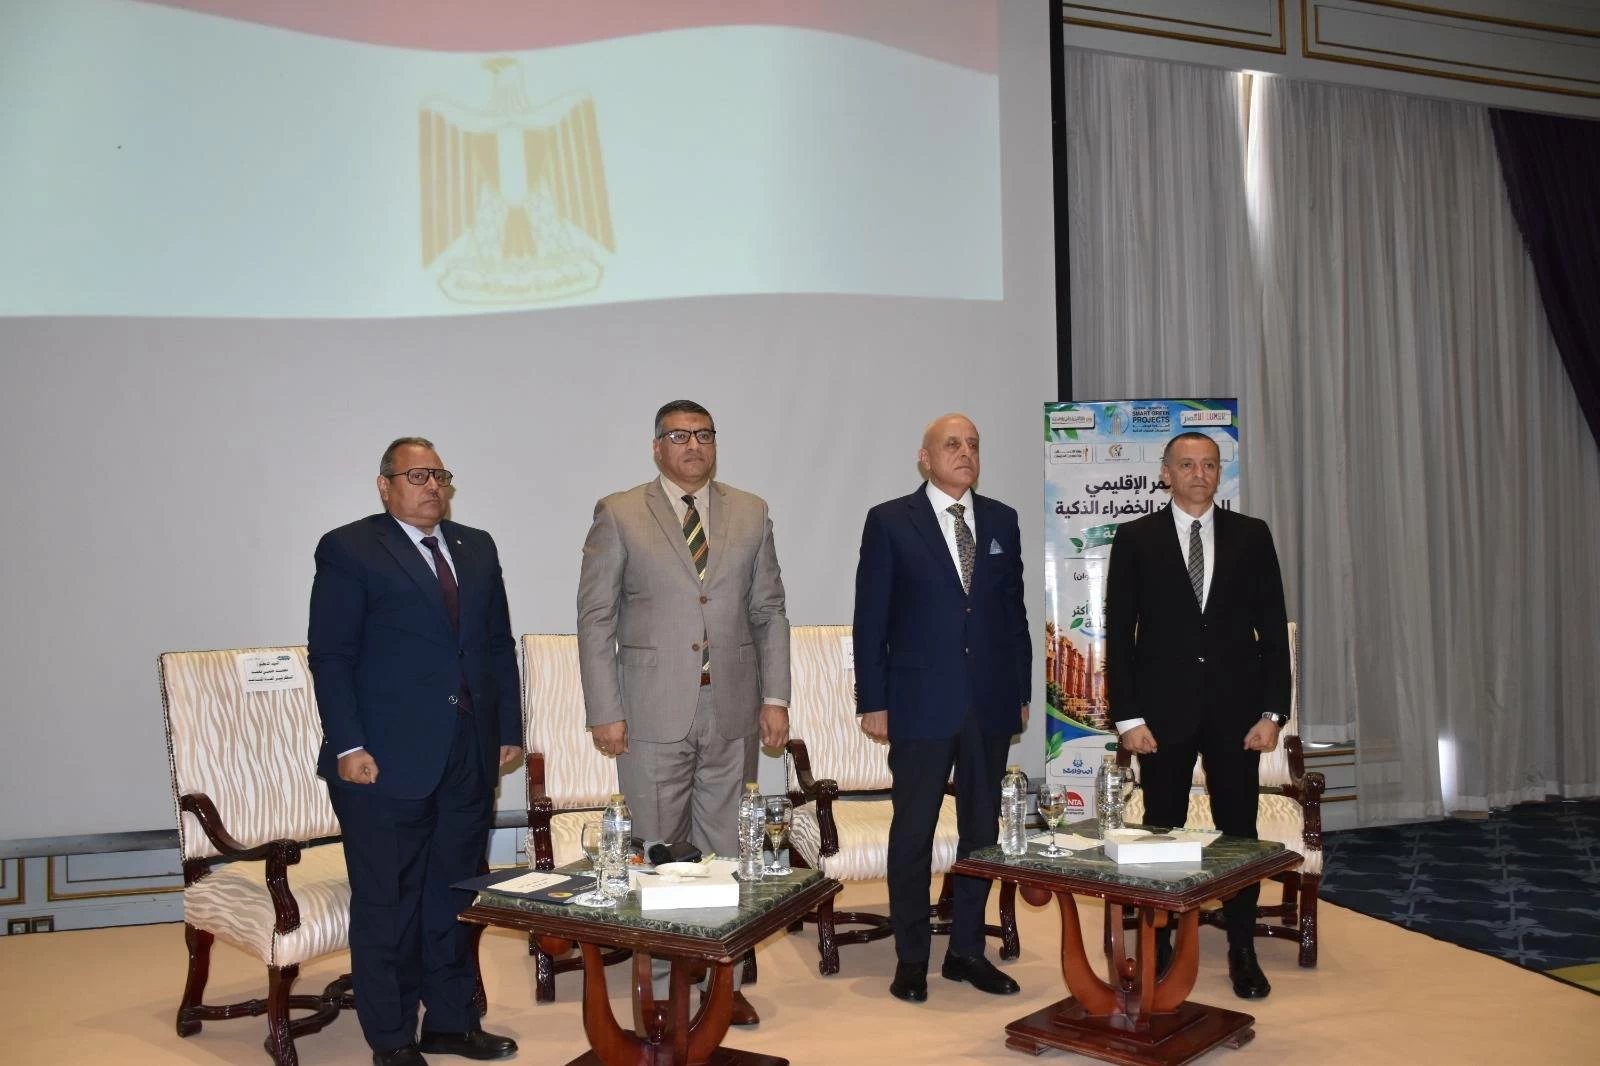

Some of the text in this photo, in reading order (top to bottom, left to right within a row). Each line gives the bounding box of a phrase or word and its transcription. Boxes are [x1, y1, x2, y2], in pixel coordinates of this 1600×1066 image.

[1085, 475, 1147, 497] الإقليمي
[1055, 500, 1098, 518] الذكية
[1101, 499, 1153, 518] الخضراء
